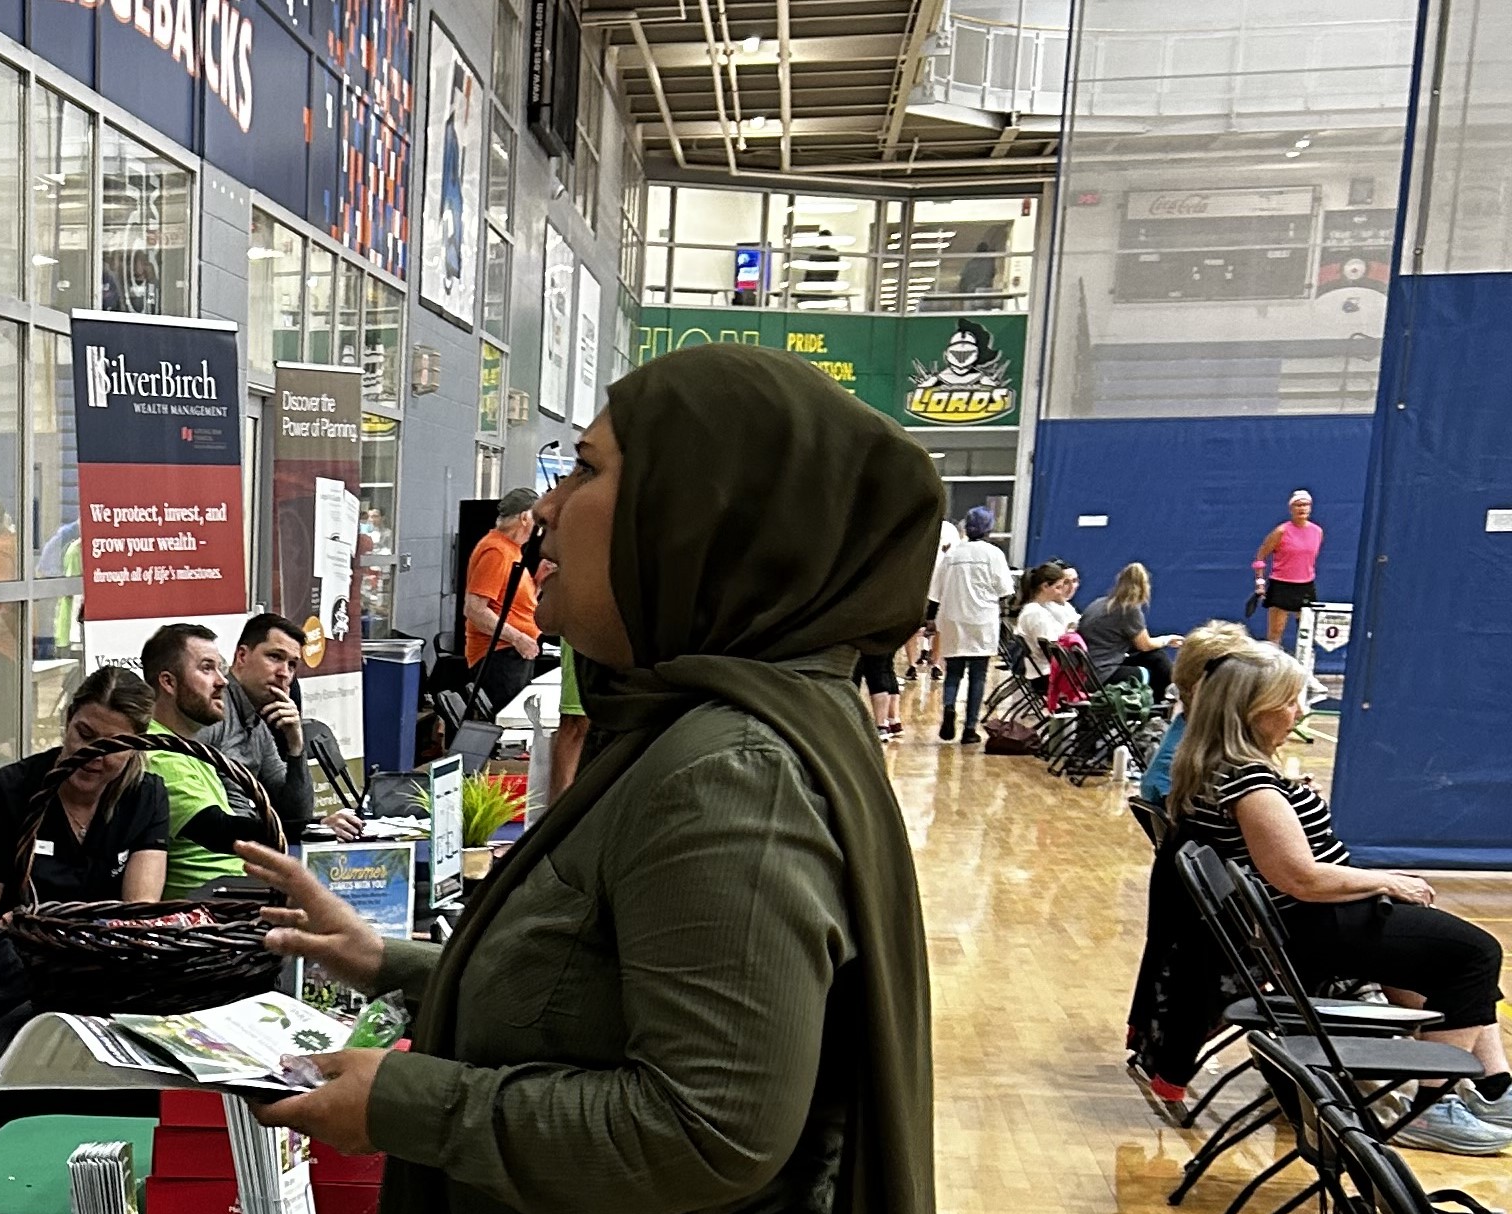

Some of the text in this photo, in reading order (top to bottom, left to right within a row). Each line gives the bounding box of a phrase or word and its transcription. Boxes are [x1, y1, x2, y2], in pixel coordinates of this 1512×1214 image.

[98, 0, 253, 134] EBACKS
[787, 333, 828, 353] PRIDE.
[96, 353, 218, 400] SilverBirch
[810, 361, 856, 381] ITION.
[133, 403, 228, 417] WEALTH MANAGEMENT
[282, 390, 320, 412] Discover
[910, 388, 1010, 414] LORDS
[282, 416, 310, 437] Power
[89, 502, 227, 527] We protect, invest, and
[92, 537, 125, 559] grow
[126, 537, 155, 557] your
[157, 531, 197, 552] wealth
[93, 567, 130, 586] through
[329, 854, 388, 881] Summer
